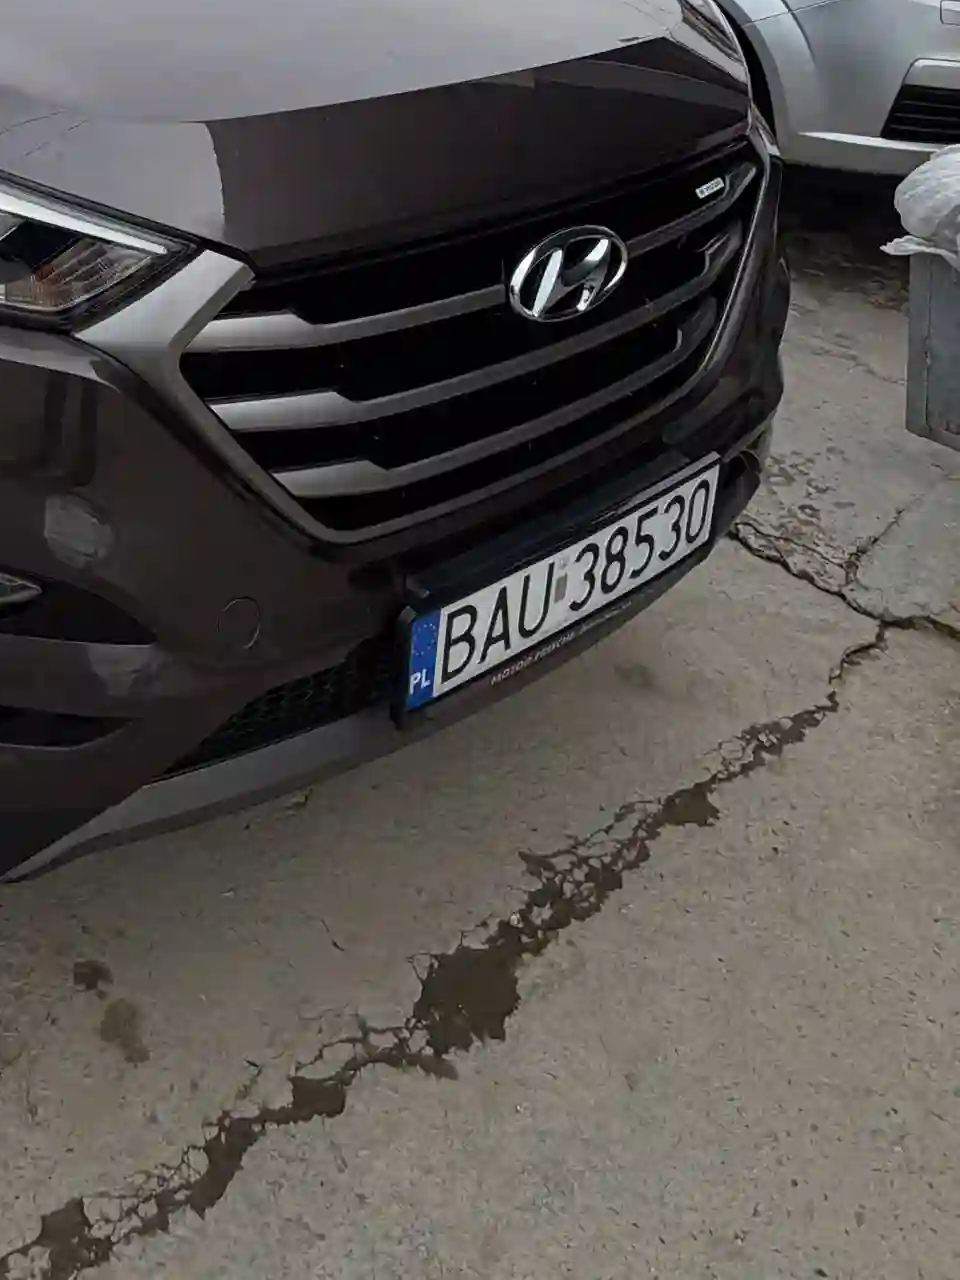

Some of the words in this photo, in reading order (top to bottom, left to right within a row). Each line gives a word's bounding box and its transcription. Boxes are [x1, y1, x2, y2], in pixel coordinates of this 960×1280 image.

[441, 561, 555, 685] BAU
[569, 478, 711, 612] 38530
[409, 669, 431, 695] PL
